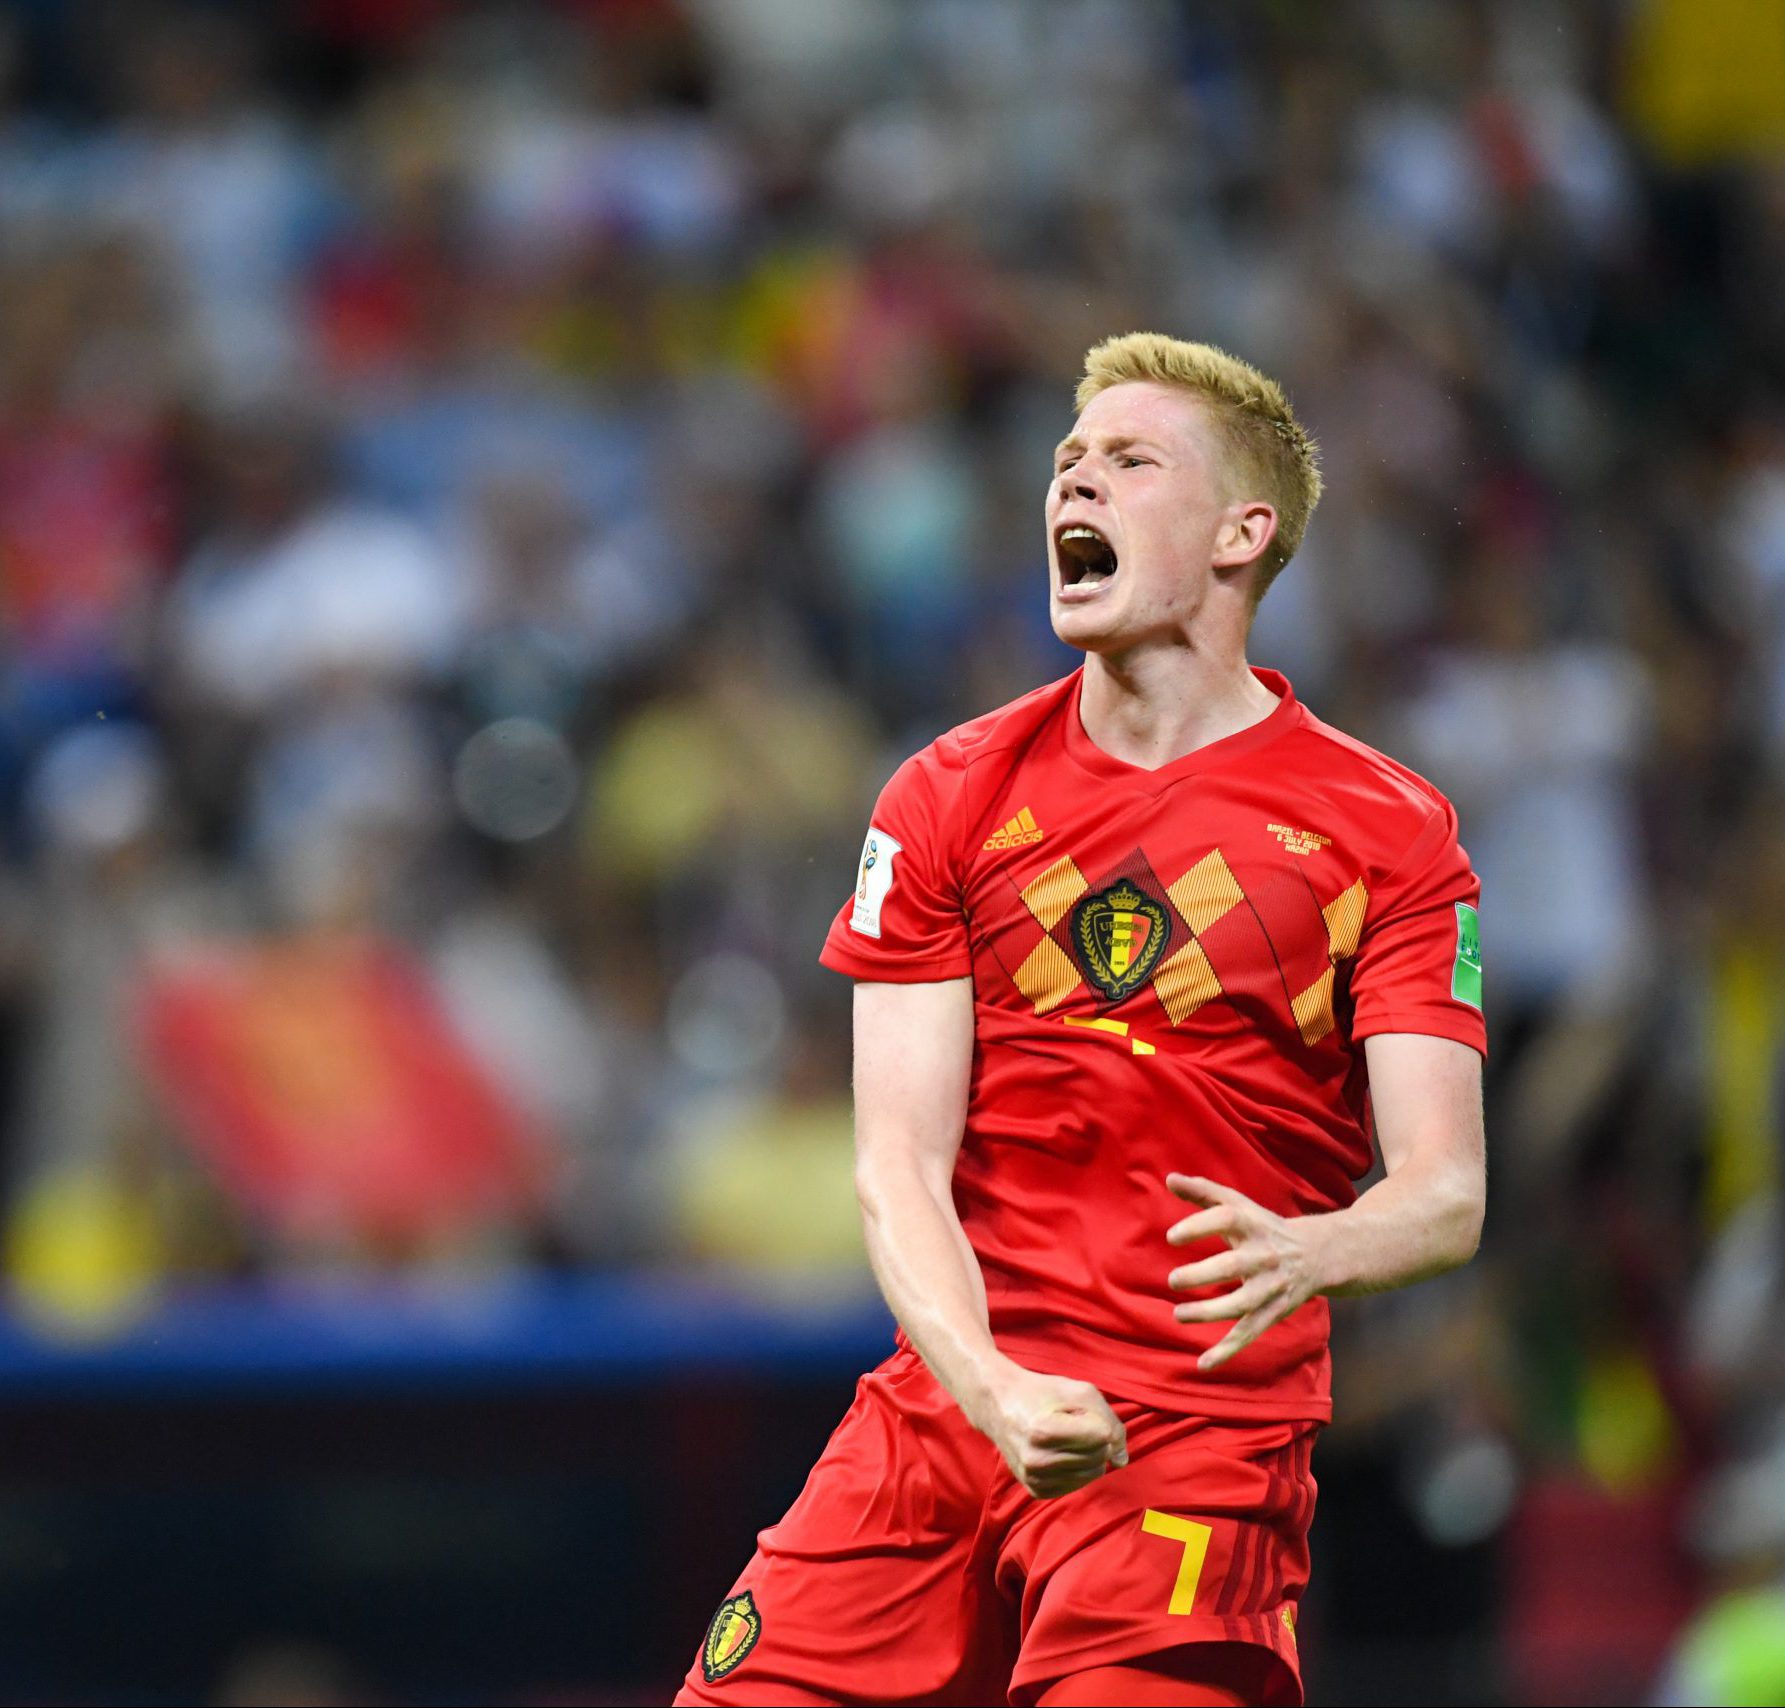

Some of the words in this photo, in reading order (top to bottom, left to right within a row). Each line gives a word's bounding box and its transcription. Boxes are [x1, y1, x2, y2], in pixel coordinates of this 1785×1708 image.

[982, 829, 1044, 851] adidas
[1267, 823, 1294, 836] BRAZIL
[1301, 831, 1332, 847] BELGIUM
[1284, 835, 1302, 846] JULY
[1303, 840, 1321, 851] 2018
[1285, 843, 1310, 856] KAZAN
[1141, 1508, 1213, 1616] 7
